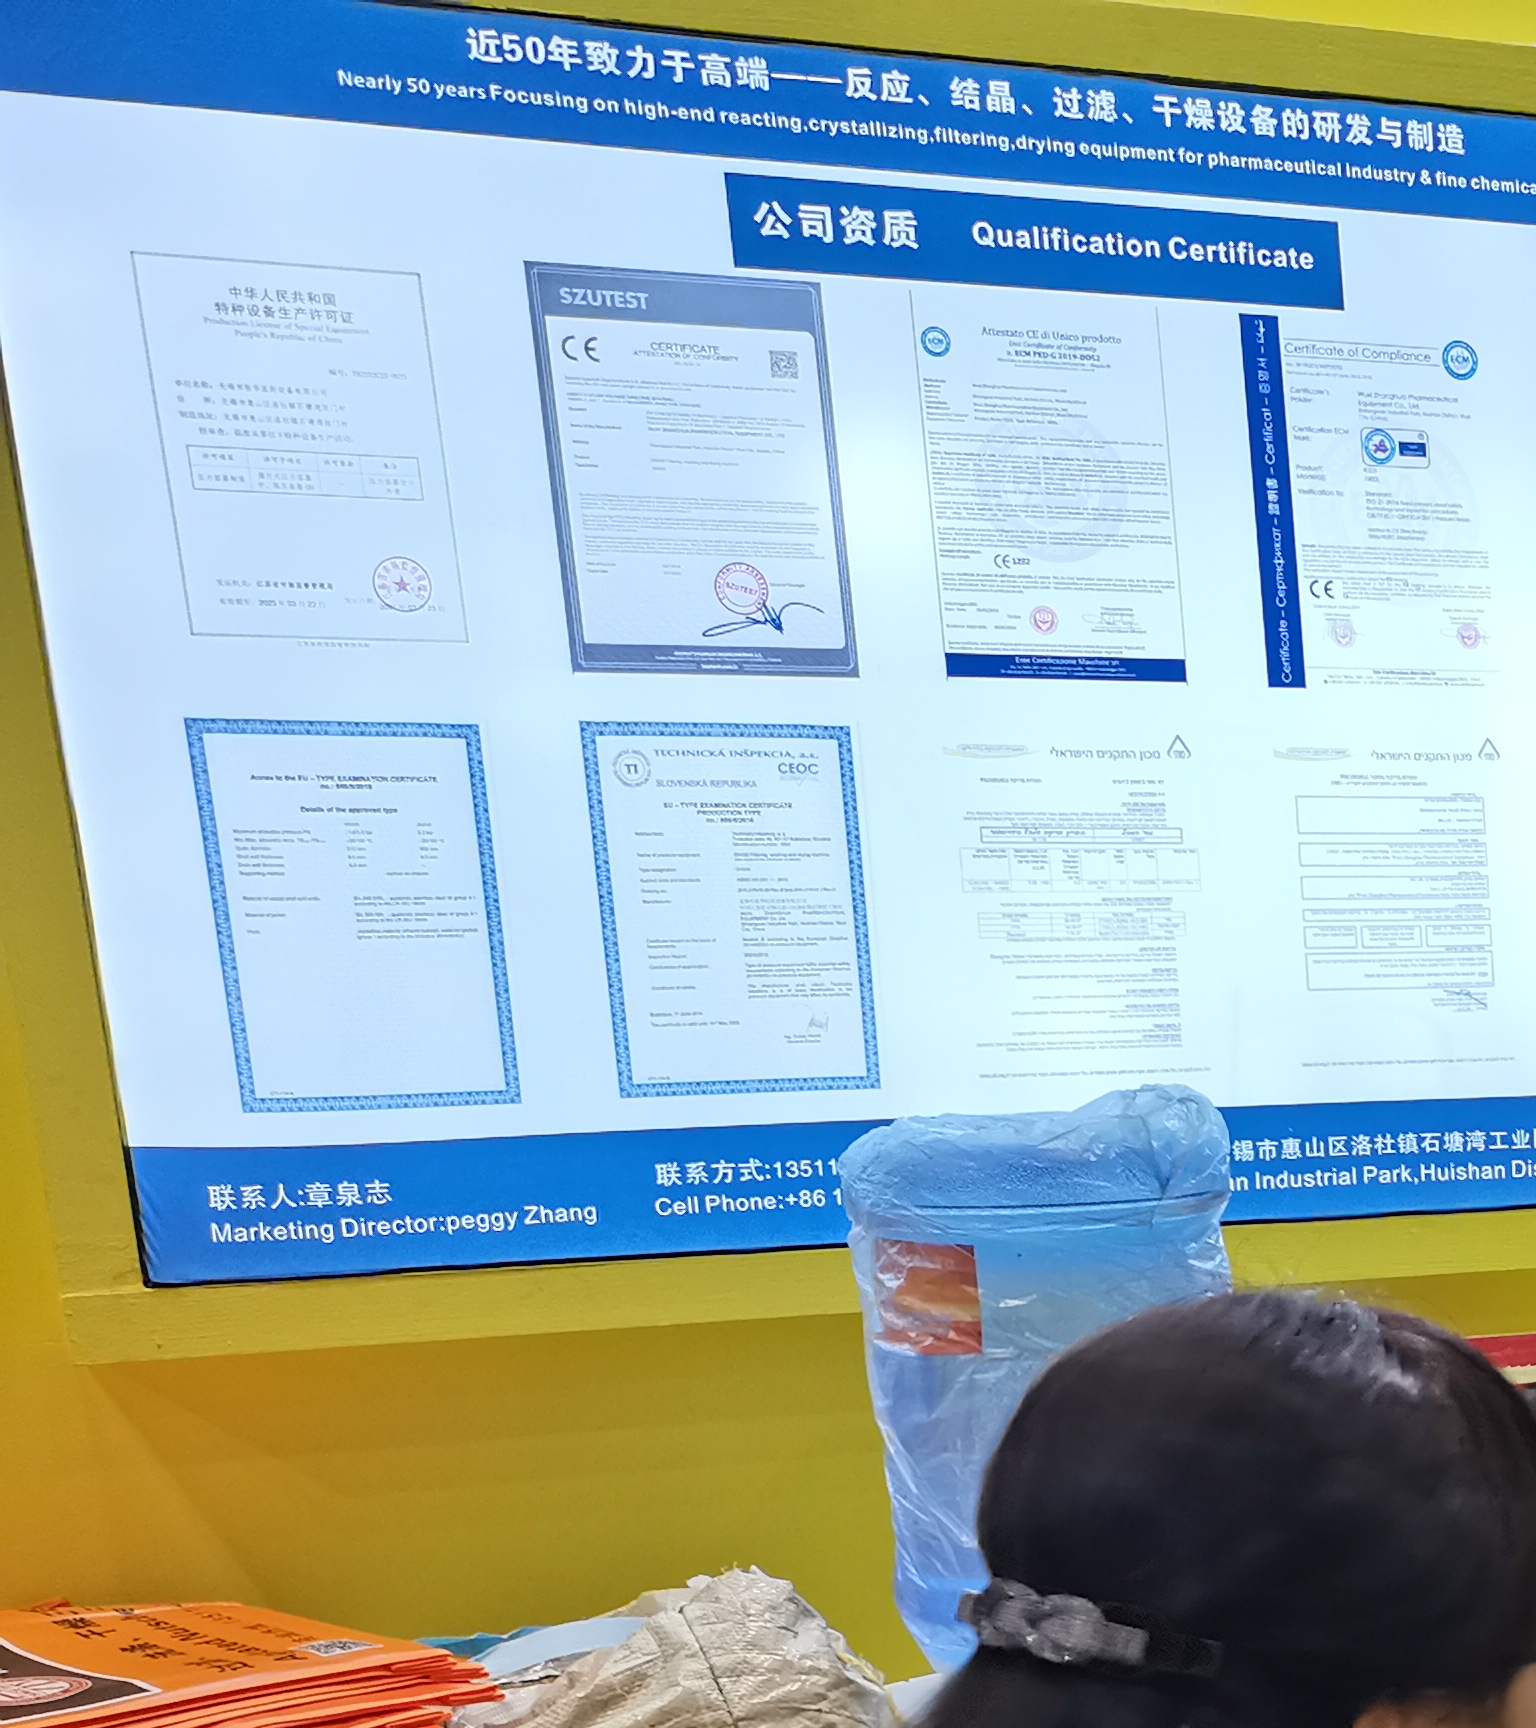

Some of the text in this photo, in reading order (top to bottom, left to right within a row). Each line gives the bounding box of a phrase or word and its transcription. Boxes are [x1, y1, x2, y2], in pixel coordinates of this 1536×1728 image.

[337, 69, 402, 97] Nearly
[405, 77, 430, 96] 50
[434, 82, 487, 104] years
[490, 84, 588, 117] Focusing
[593, 99, 620, 115] on
[624, 99, 715, 128] high-end
[1078, 141, 1176, 168] equipment
[1177, 147, 1204, 164] for
[1207, 150, 1342, 180] pharmaceutical
[1420, 170, 1432, 186] &
[1435, 168, 1467, 190] fine
[755, 201, 919, 250] 公司资质
[971, 219, 1315, 272] Qualification Certificate
[229, 286, 337, 307] 中华人民共和国
[559, 287, 649, 310] SZUTEST
[214, 302, 355, 325] 特种设备生产许可证
[561, 335, 601, 363] CE
[650, 341, 721, 355] CERTIFICATE
[1284, 342, 1432, 364] Certificate of Compliance
[777, 762, 820, 775] CEOC
[1254, 1157, 1359, 1190] Industrial
[207, 1179, 392, 1212] 联系人:章泉志
[655, 1192, 700, 1217] Cell
[211, 1202, 599, 1246] Marketing Director:peggy Zhang
